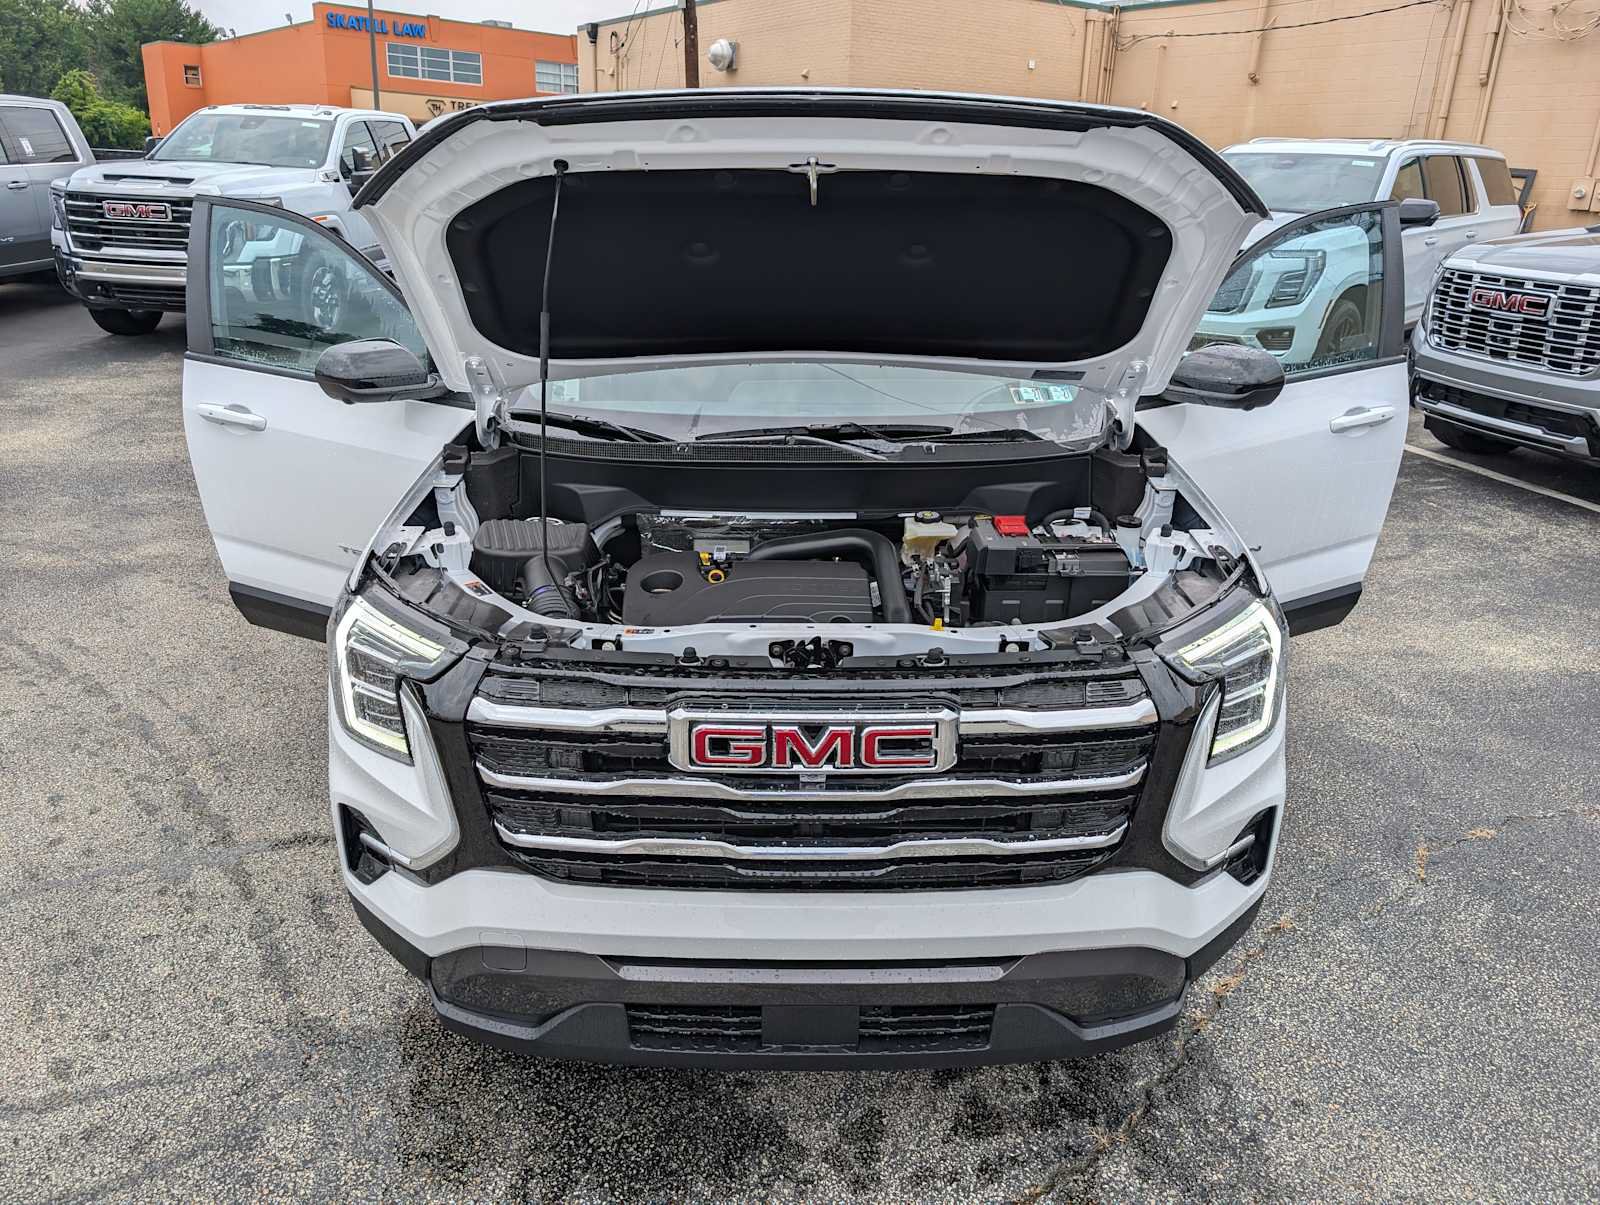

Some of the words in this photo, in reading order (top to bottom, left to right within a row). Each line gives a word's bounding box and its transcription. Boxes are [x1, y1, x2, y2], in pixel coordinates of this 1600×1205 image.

[393, 21, 426, 39] LAW
[107, 203, 168, 219] GMC
[1471, 288, 1549, 316] GMC
[692, 724, 938, 769] GMC
